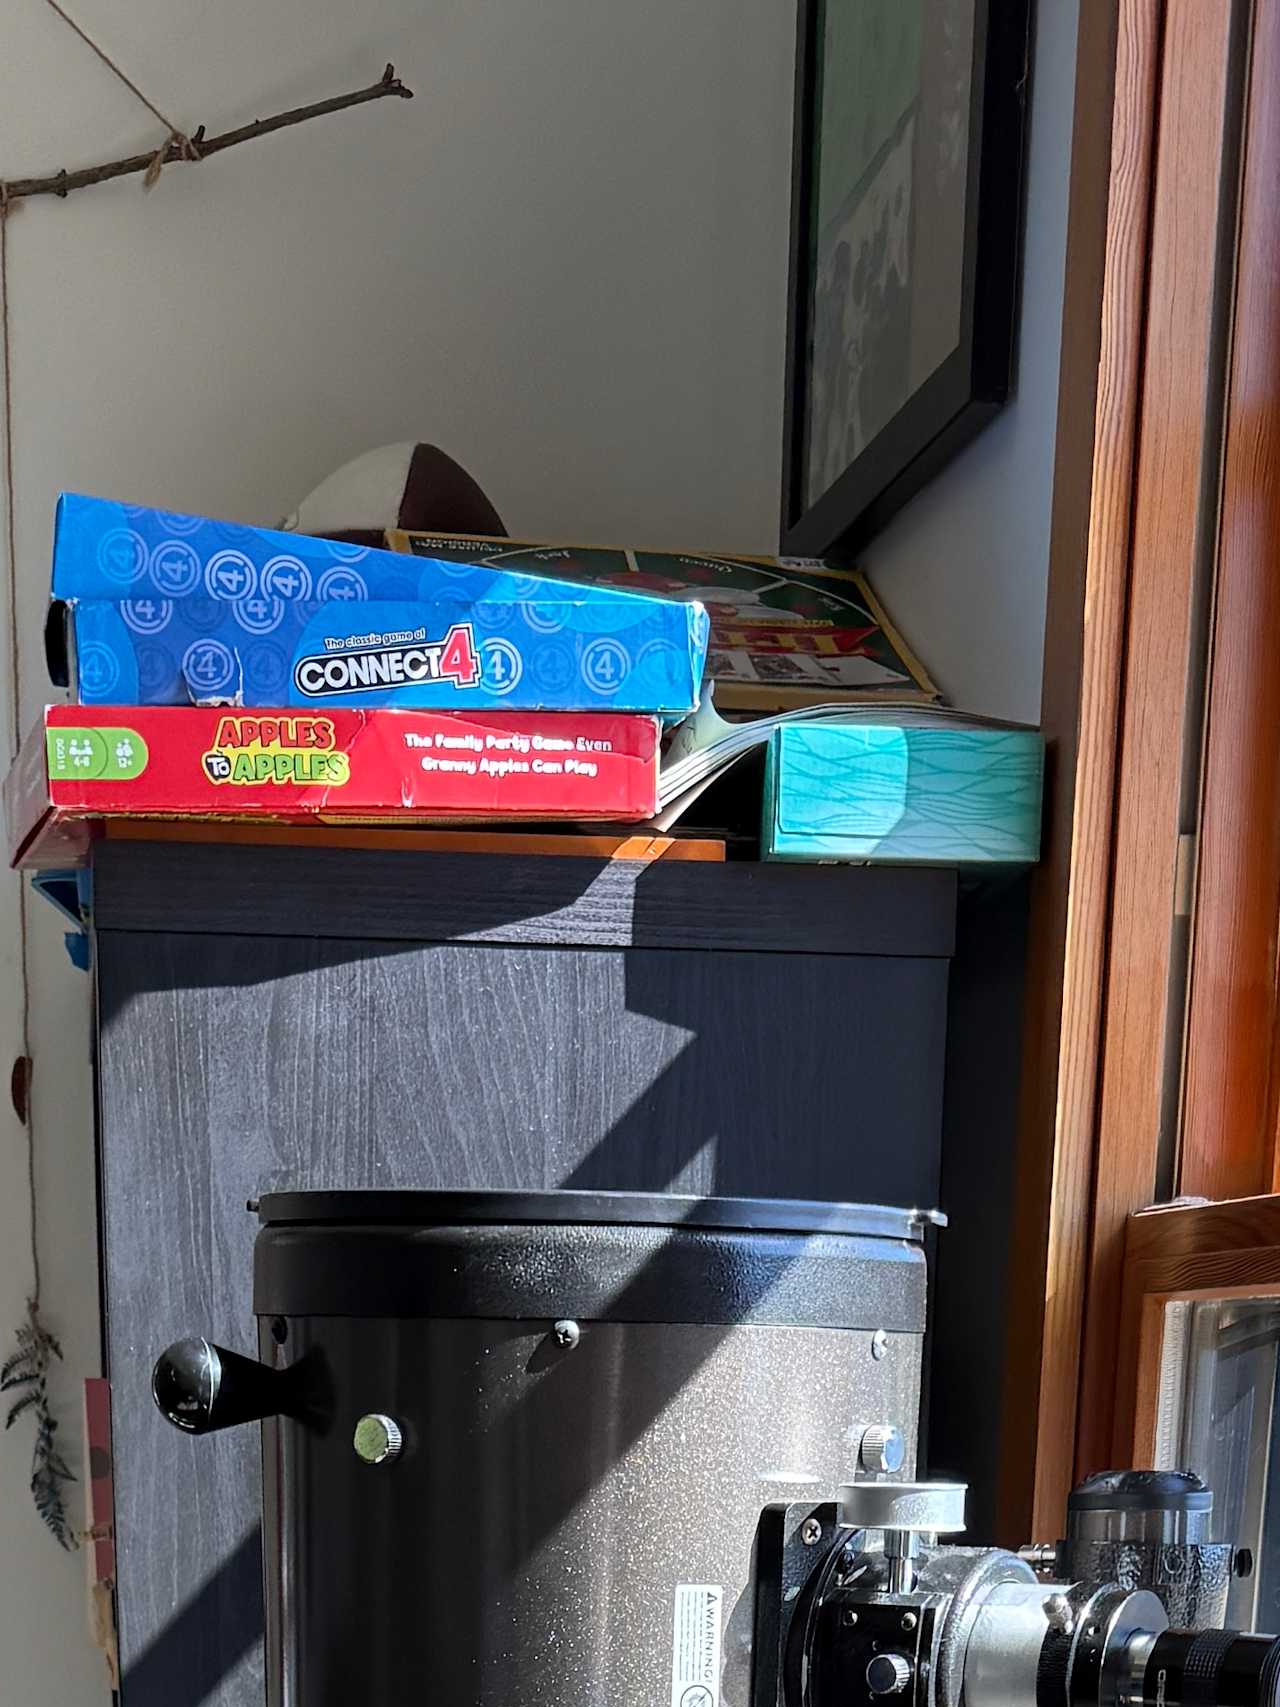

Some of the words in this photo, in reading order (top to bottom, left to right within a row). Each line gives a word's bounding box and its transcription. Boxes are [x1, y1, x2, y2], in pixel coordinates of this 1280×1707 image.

[324, 635, 344, 650] The
[345, 633, 381, 648] classic
[383, 630, 413, 647] game
[299, 645, 442, 688] CONNECT
[439, 628, 477, 684] 4
[218, 719, 333, 748] APPLES
[405, 733, 432, 748] The
[435, 734, 483, 752] Family
[485, 735, 530, 753] Party
[532, 736, 575, 751] Game
[576, 737, 612, 752] Even
[232, 753, 347, 782] APPLES
[421, 756, 477, 775] Granny
[479, 758, 530, 777] Apples
[532, 759, 563, 774] Can
[564, 759, 598, 777] Play
[704, 1607, 716, 1684] WARNING!
